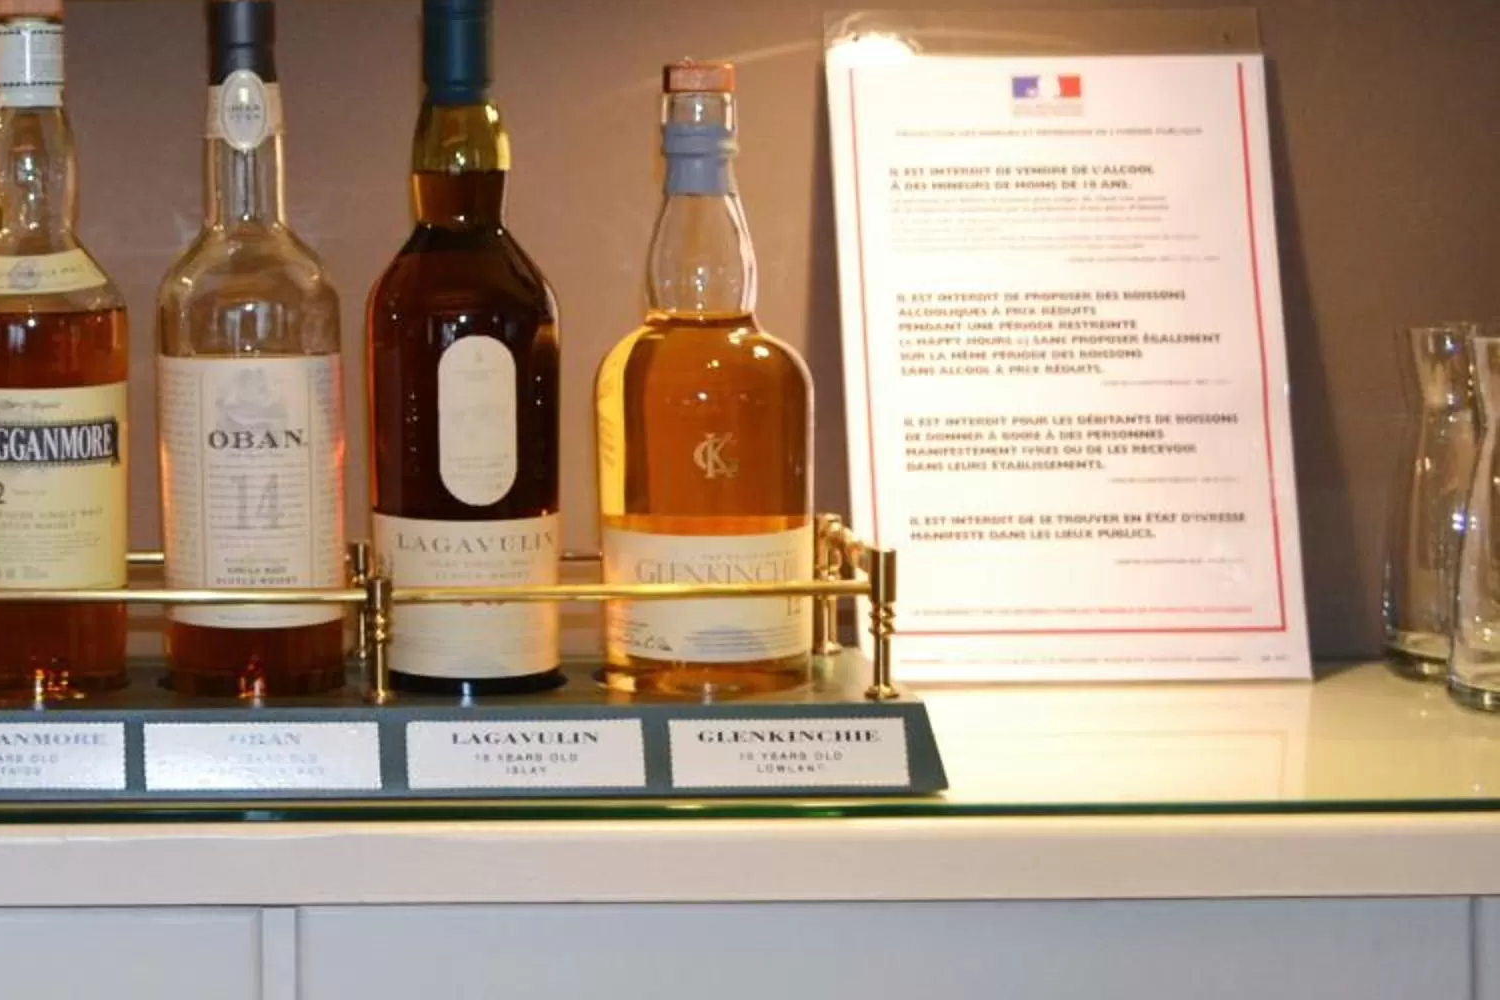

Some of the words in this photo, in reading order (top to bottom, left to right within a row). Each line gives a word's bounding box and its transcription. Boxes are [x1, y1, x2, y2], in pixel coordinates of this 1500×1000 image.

[1070, 164, 1088, 175] DE
[1060, 179, 1078, 190] DE
[207, 429, 306, 450] OBAN
[451, 731, 600, 745] LAGAVULIN
[696, 729, 882, 743] GLENKINCHIE
[548, 752, 579, 763] OLD
[814, 750, 844, 762] OLD
